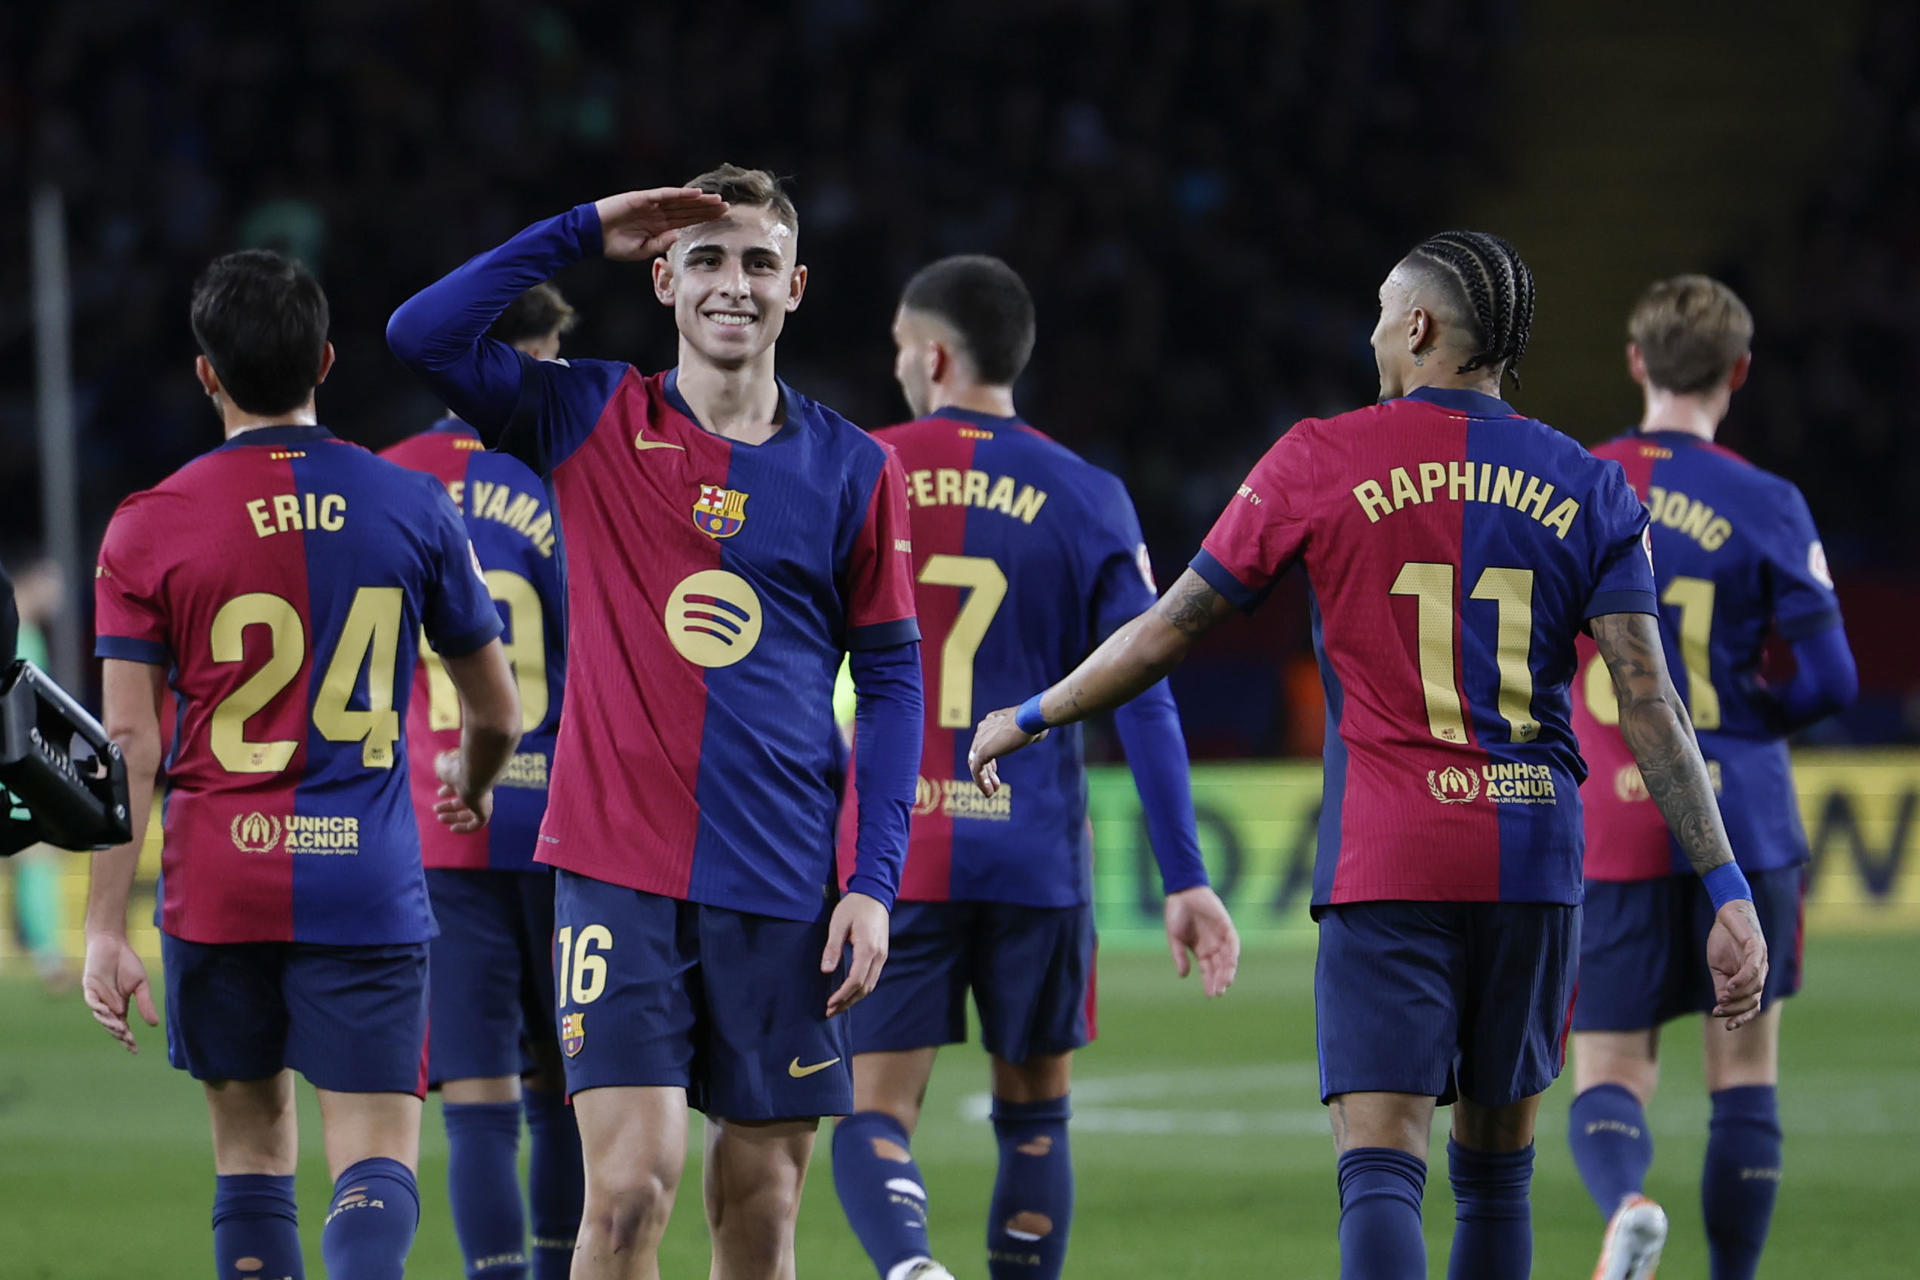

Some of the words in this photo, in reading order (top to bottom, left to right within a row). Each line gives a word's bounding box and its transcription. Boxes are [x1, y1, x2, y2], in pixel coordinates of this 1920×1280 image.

[246, 492, 347, 538] ERIC
[1352, 461, 1581, 540] RAPHINHA
[916, 553, 1009, 729] 7
[1388, 561, 1542, 745] 11
[210, 585, 405, 774] 24
[1482, 763, 1553, 781] UNHCR
[1485, 780, 1556, 798] ACNUR
[284, 815, 359, 832] UNHCR
[284, 831, 359, 848] ACNUR
[558, 923, 614, 1009] 16
